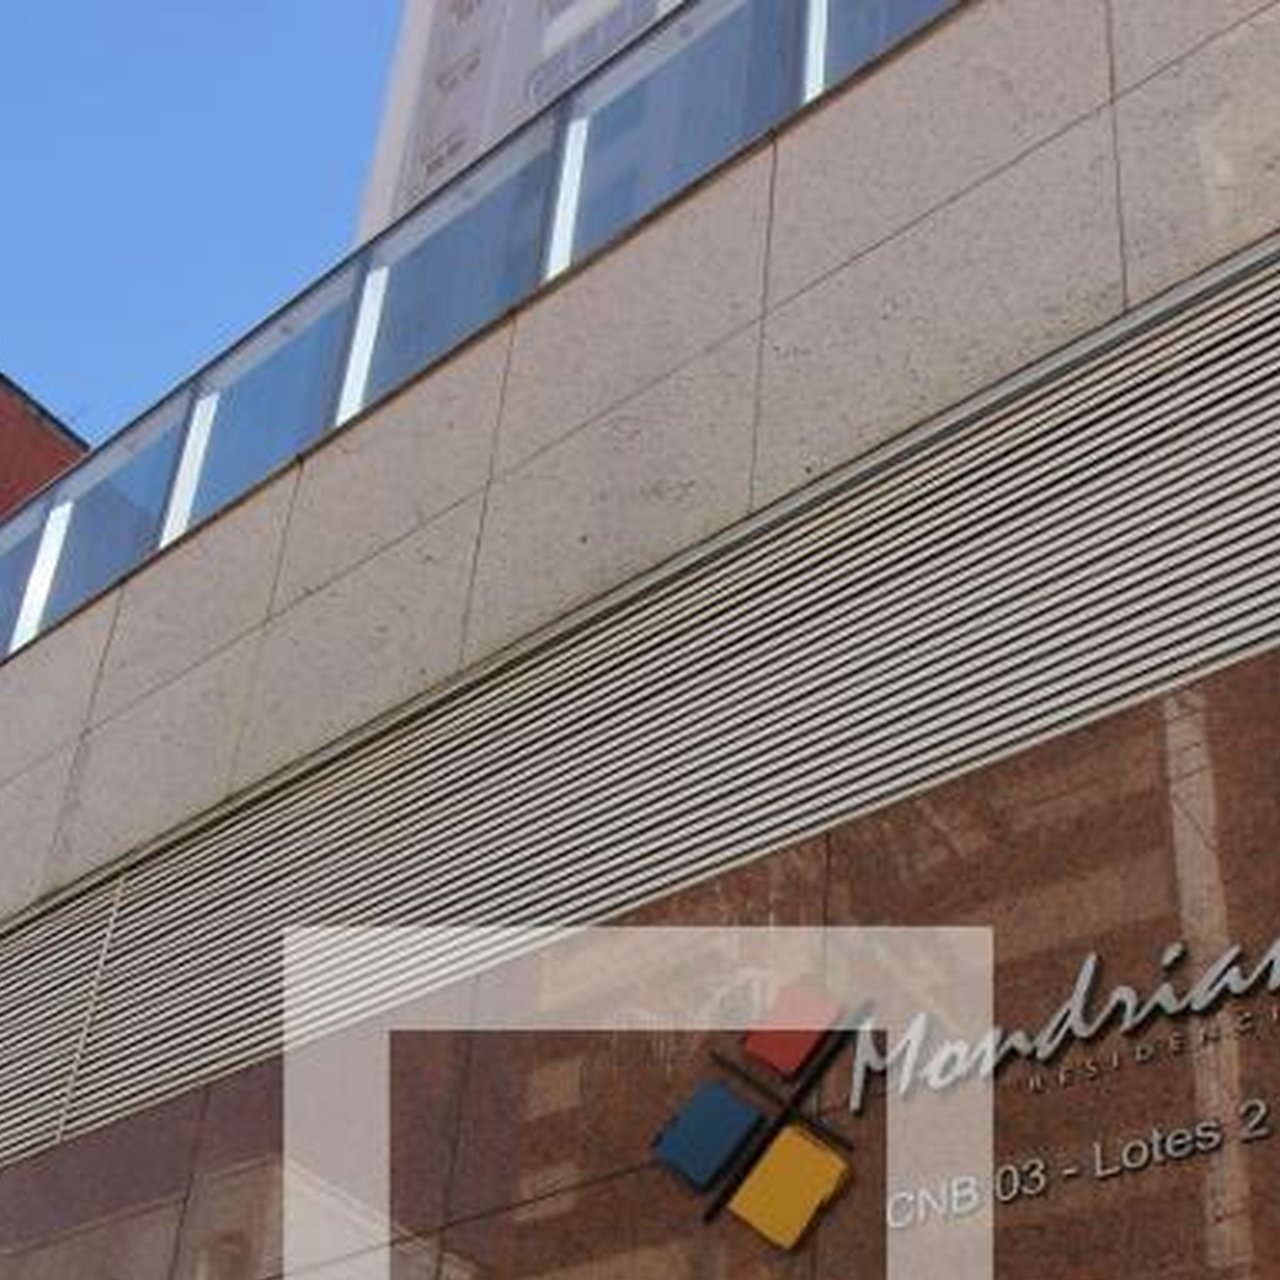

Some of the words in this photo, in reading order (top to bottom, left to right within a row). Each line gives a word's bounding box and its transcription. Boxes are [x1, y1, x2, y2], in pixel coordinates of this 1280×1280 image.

[886, 1174, 980, 1228] CNB
[995, 1157, 1047, 1202] 03
[1094, 1117, 1222, 1181] Lotes
[1238, 1098, 1272, 1142] 2
